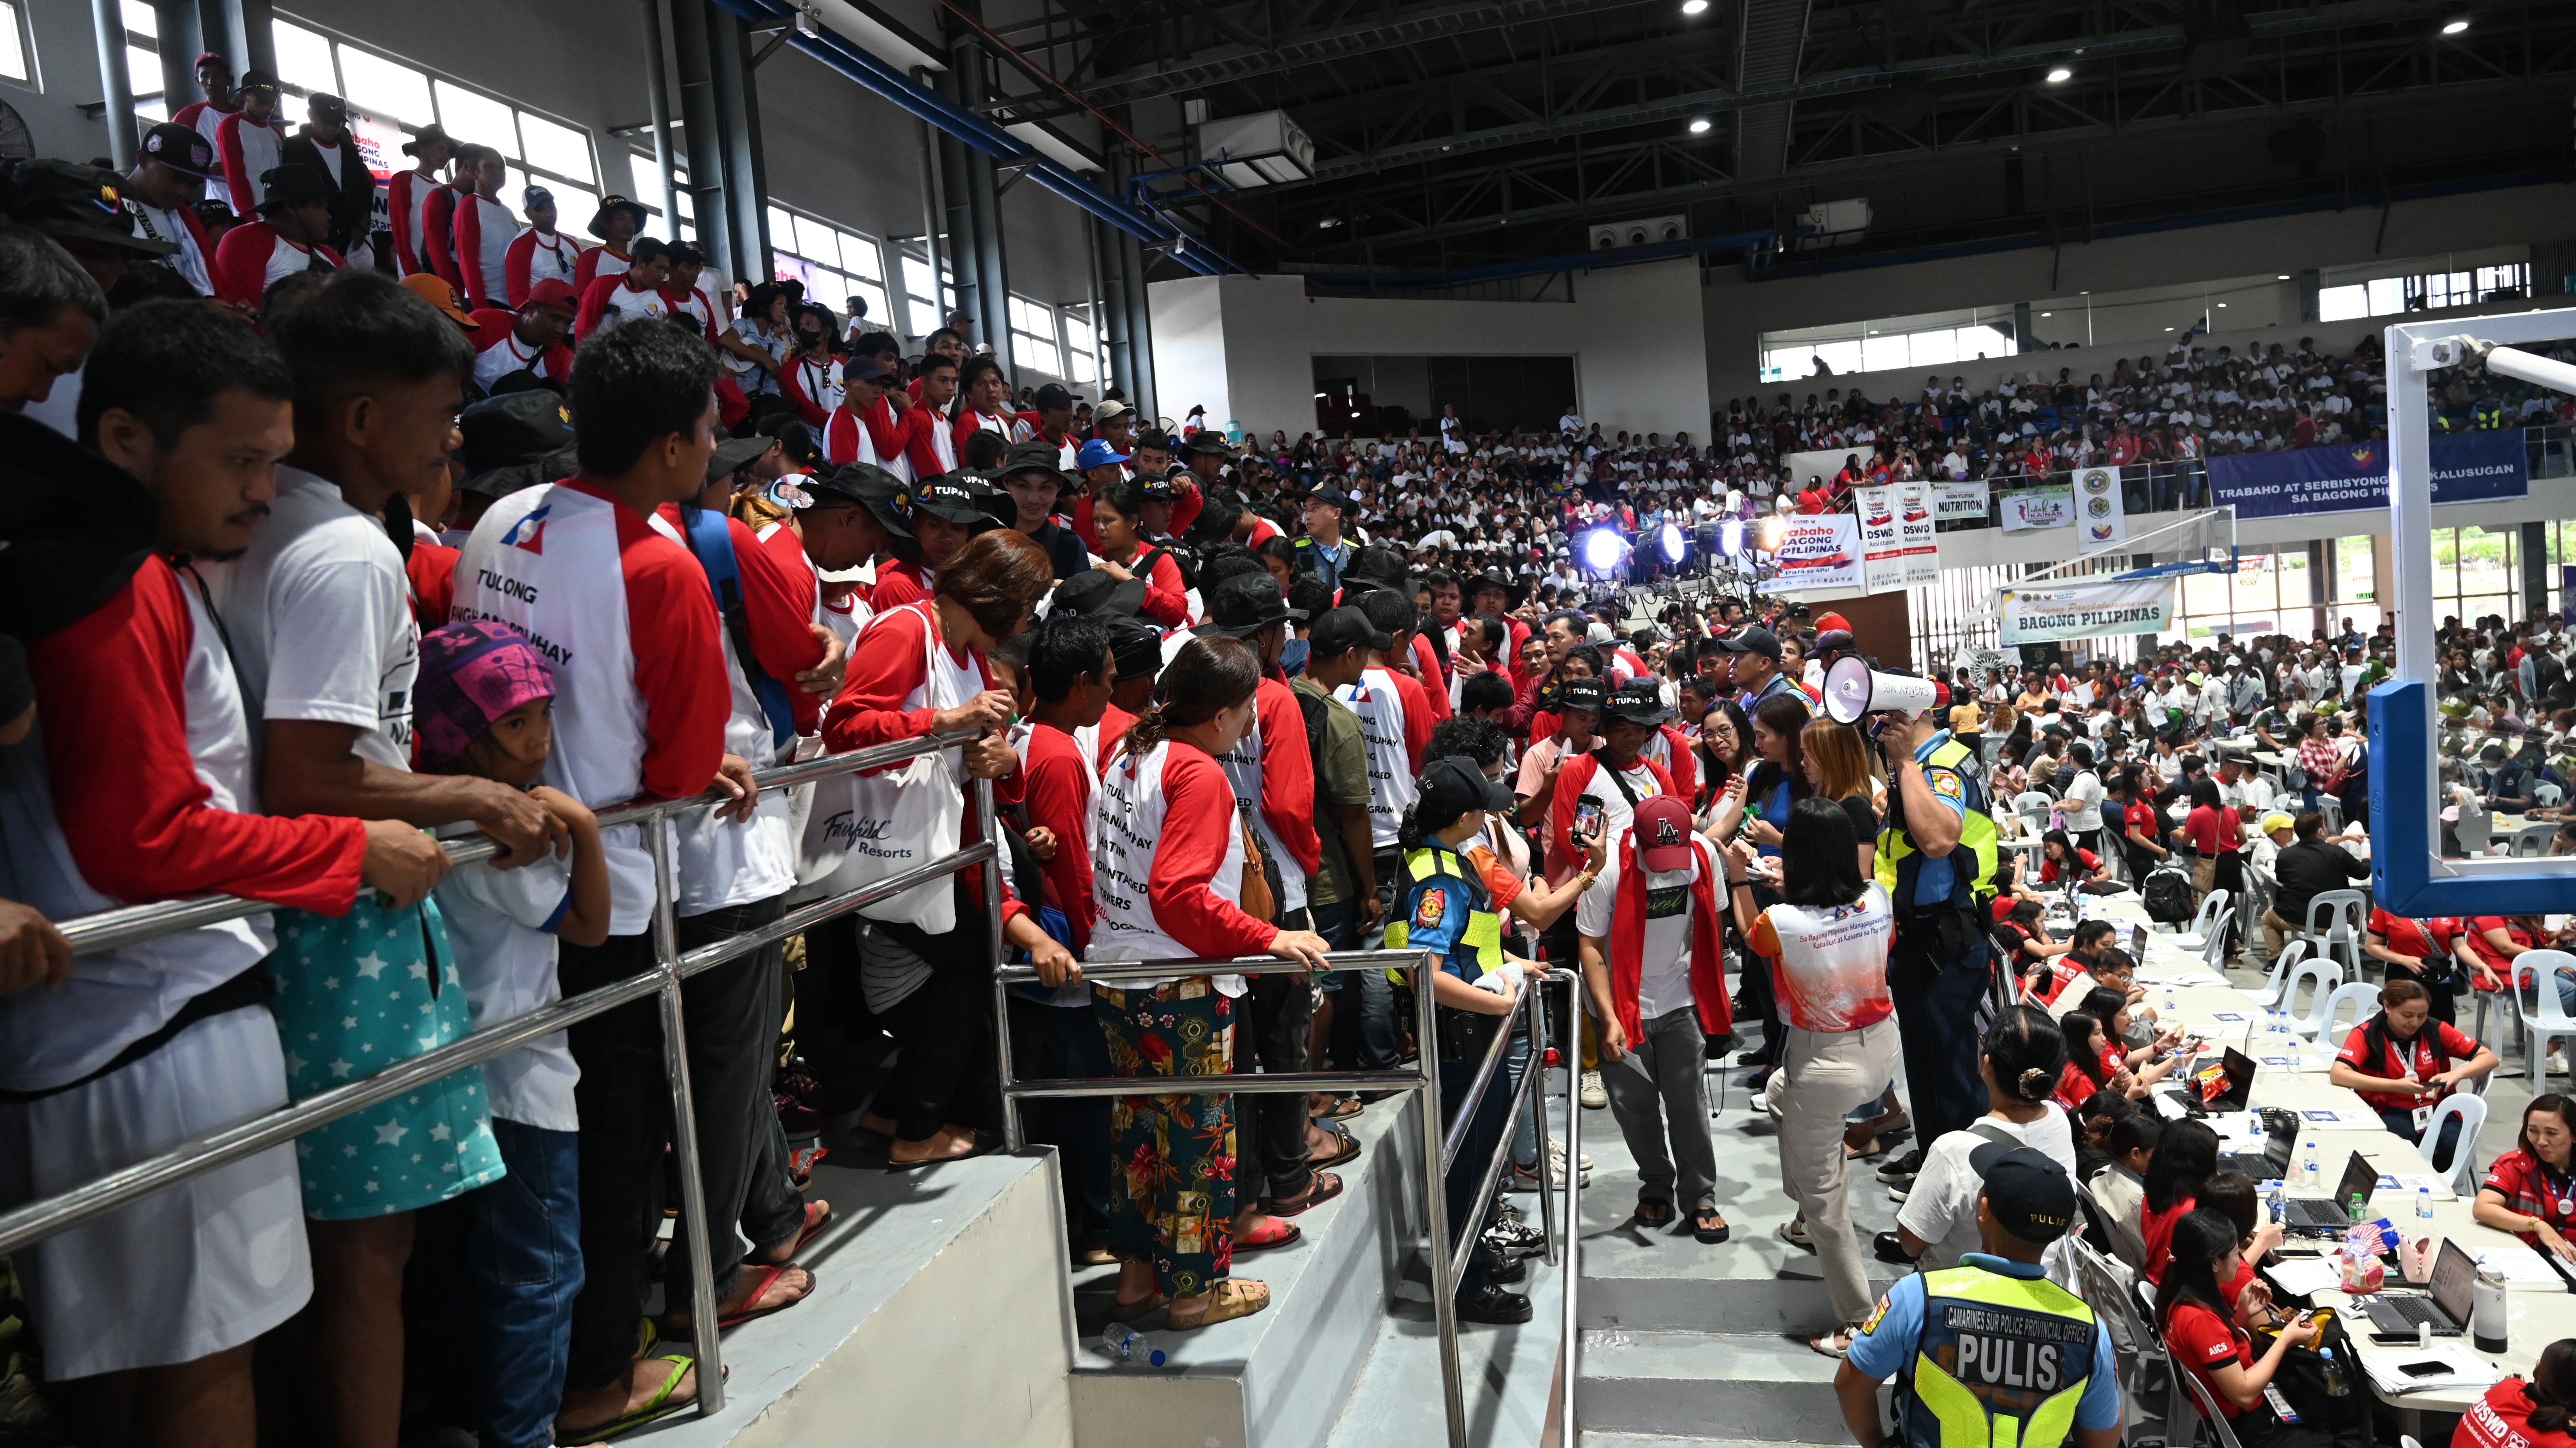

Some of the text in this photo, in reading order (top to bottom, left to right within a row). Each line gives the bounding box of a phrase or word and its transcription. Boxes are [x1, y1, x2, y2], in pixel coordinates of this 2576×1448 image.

[348, 110, 360, 119] SWD
[356, 145, 380, 157] GONG
[2218, 485, 2280, 498] TRABAHO
[2284, 483, 2300, 492] AT
[2304, 476, 2388, 490] SERBISYONG
[2291, 494, 2309, 503] SA
[2313, 489, 2368, 502] BAGONG
[1938, 500, 1982, 512] NUTRITION
[1867, 528, 1894, 540] DSWD
[1903, 524, 1930, 534] DSWD
[1780, 545, 1841, 556] PILIPINAS
[477, 569, 538, 604] TULONG
[2018, 605, 2064, 616] Serbisyong
[2068, 601, 2136, 614] Pangkalusugan
[2019, 606, 2160, 630] BAGONG PILIPINAS
[1976, 652, 2001, 661] NUTRITION
[823, 810, 891, 850] Fairfield
[1657, 818, 1679, 845] LA
[859, 841, 912, 858] Resorts
[1646, 889, 1685, 911] evel
[1808, 931, 1827, 943] Bagong
[1828, 926, 1849, 939] Pilipinas:
[1850, 916, 1883, 931] Manggagawang
[1813, 938, 1836, 949] Kabalikat
[1844, 930, 1863, 942] Kasama
[2030, 1213, 2066, 1227] PULIS
[1948, 1307, 2087, 1344] CAMARINES SUR POLICE PROVINCIAL OFFICE
[2208, 1342, 2228, 1356] AICS
[1957, 1333, 2057, 1391] PULIS
[2473, 1400, 2508, 1438] DSWD
